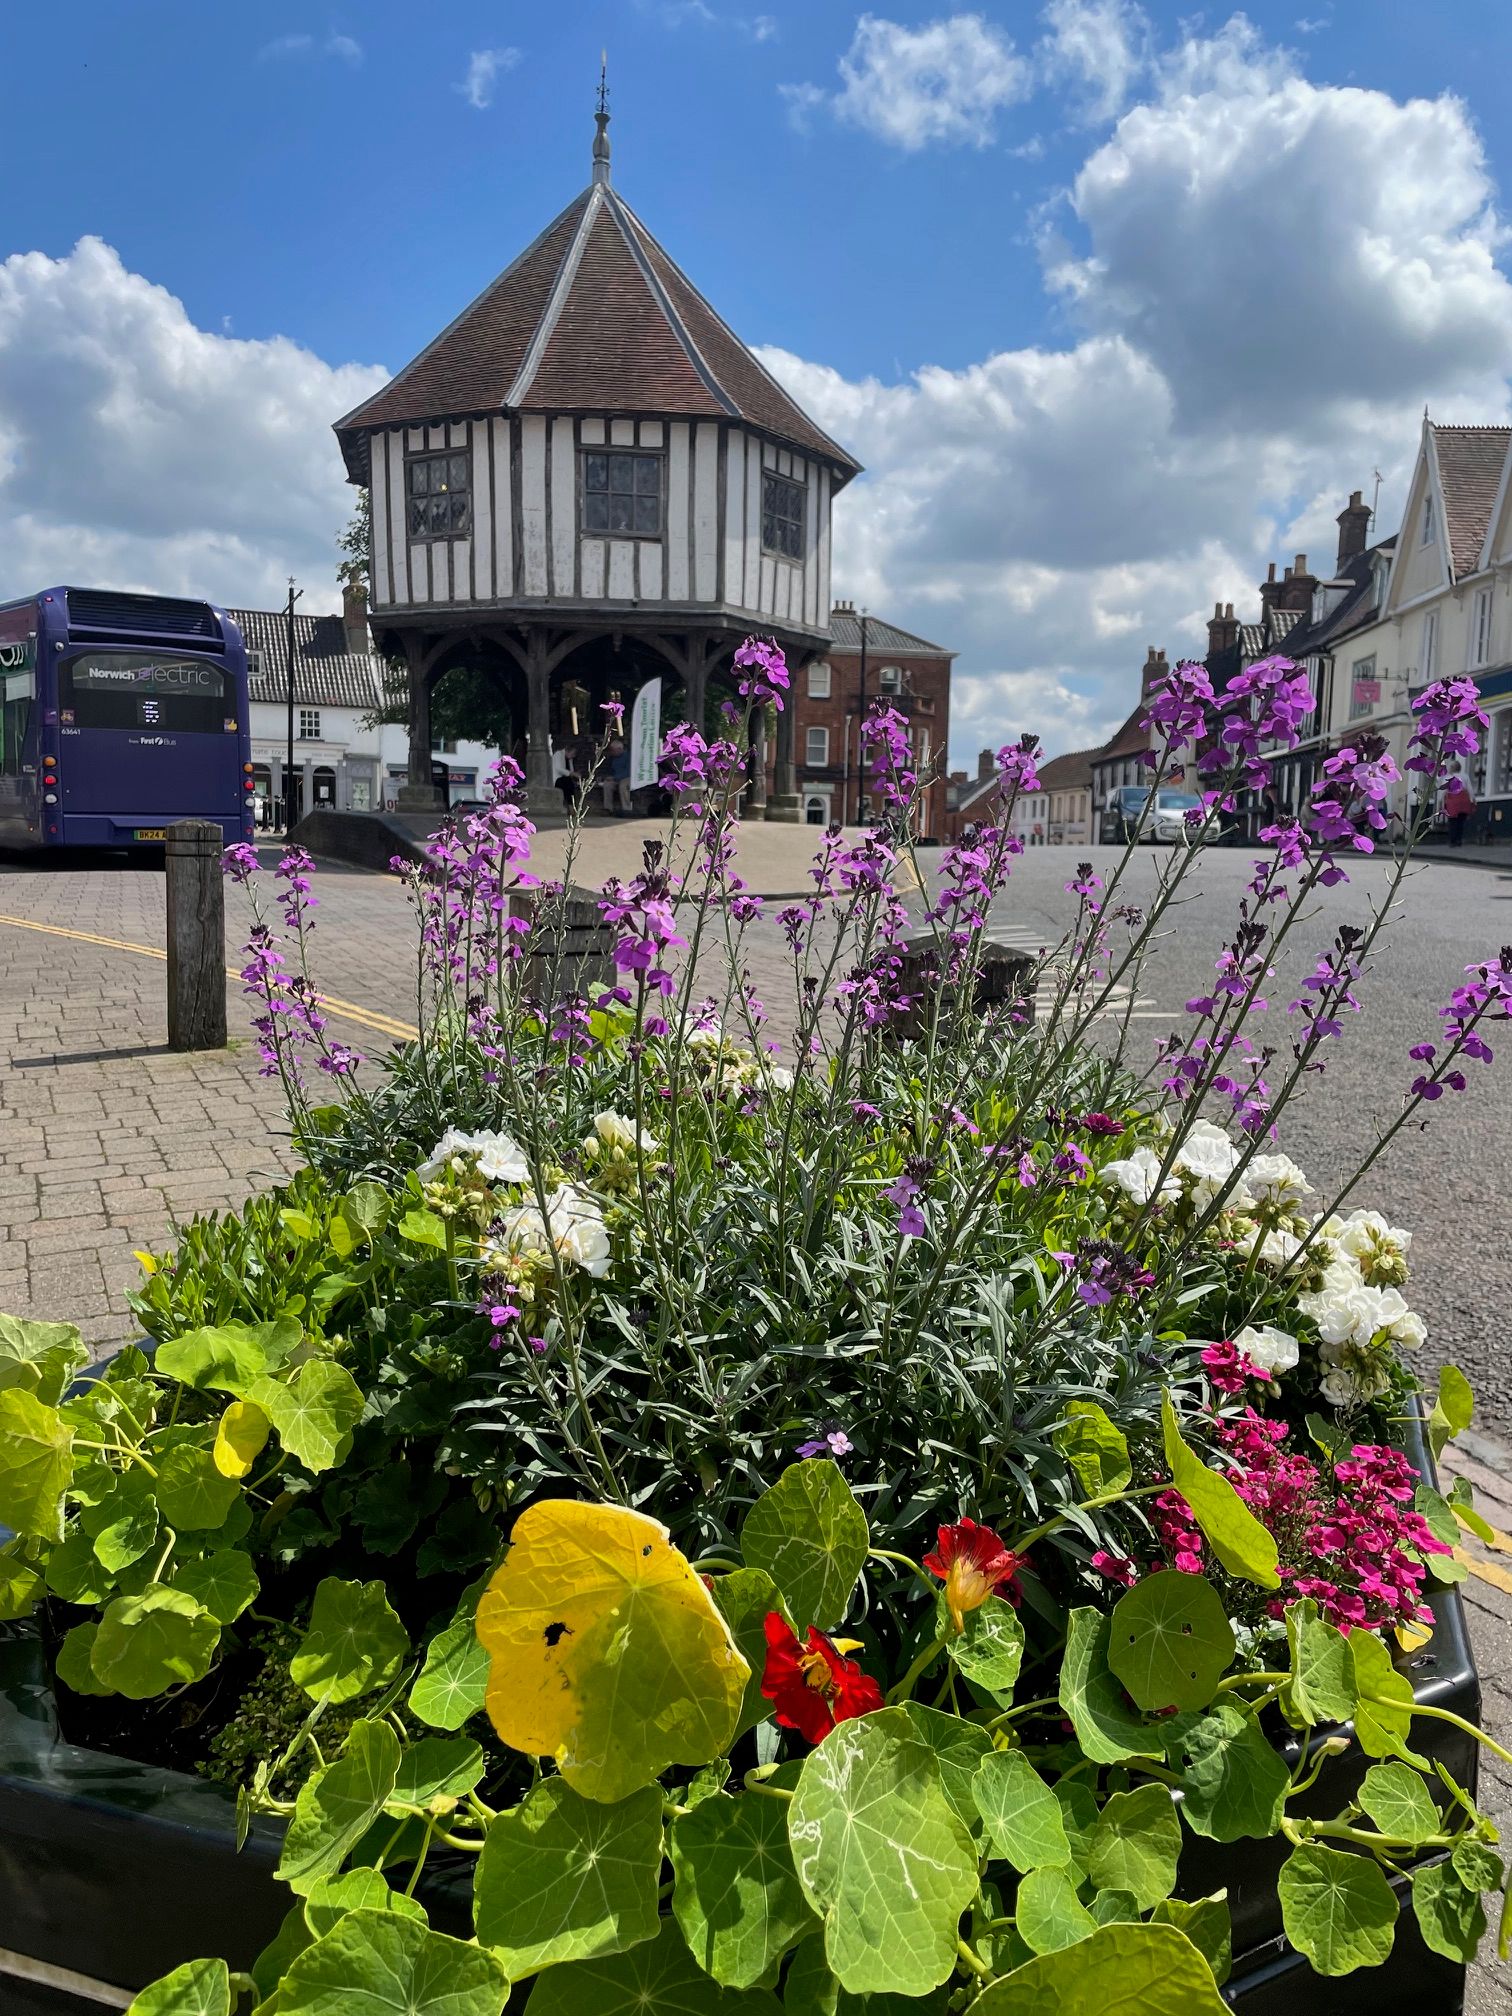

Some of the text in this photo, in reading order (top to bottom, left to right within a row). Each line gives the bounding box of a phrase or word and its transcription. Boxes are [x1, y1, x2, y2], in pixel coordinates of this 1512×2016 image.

[89, 664, 210, 685] Norwich electric
[140, 737, 155, 745] First
[163, 738, 177, 746] Bus
